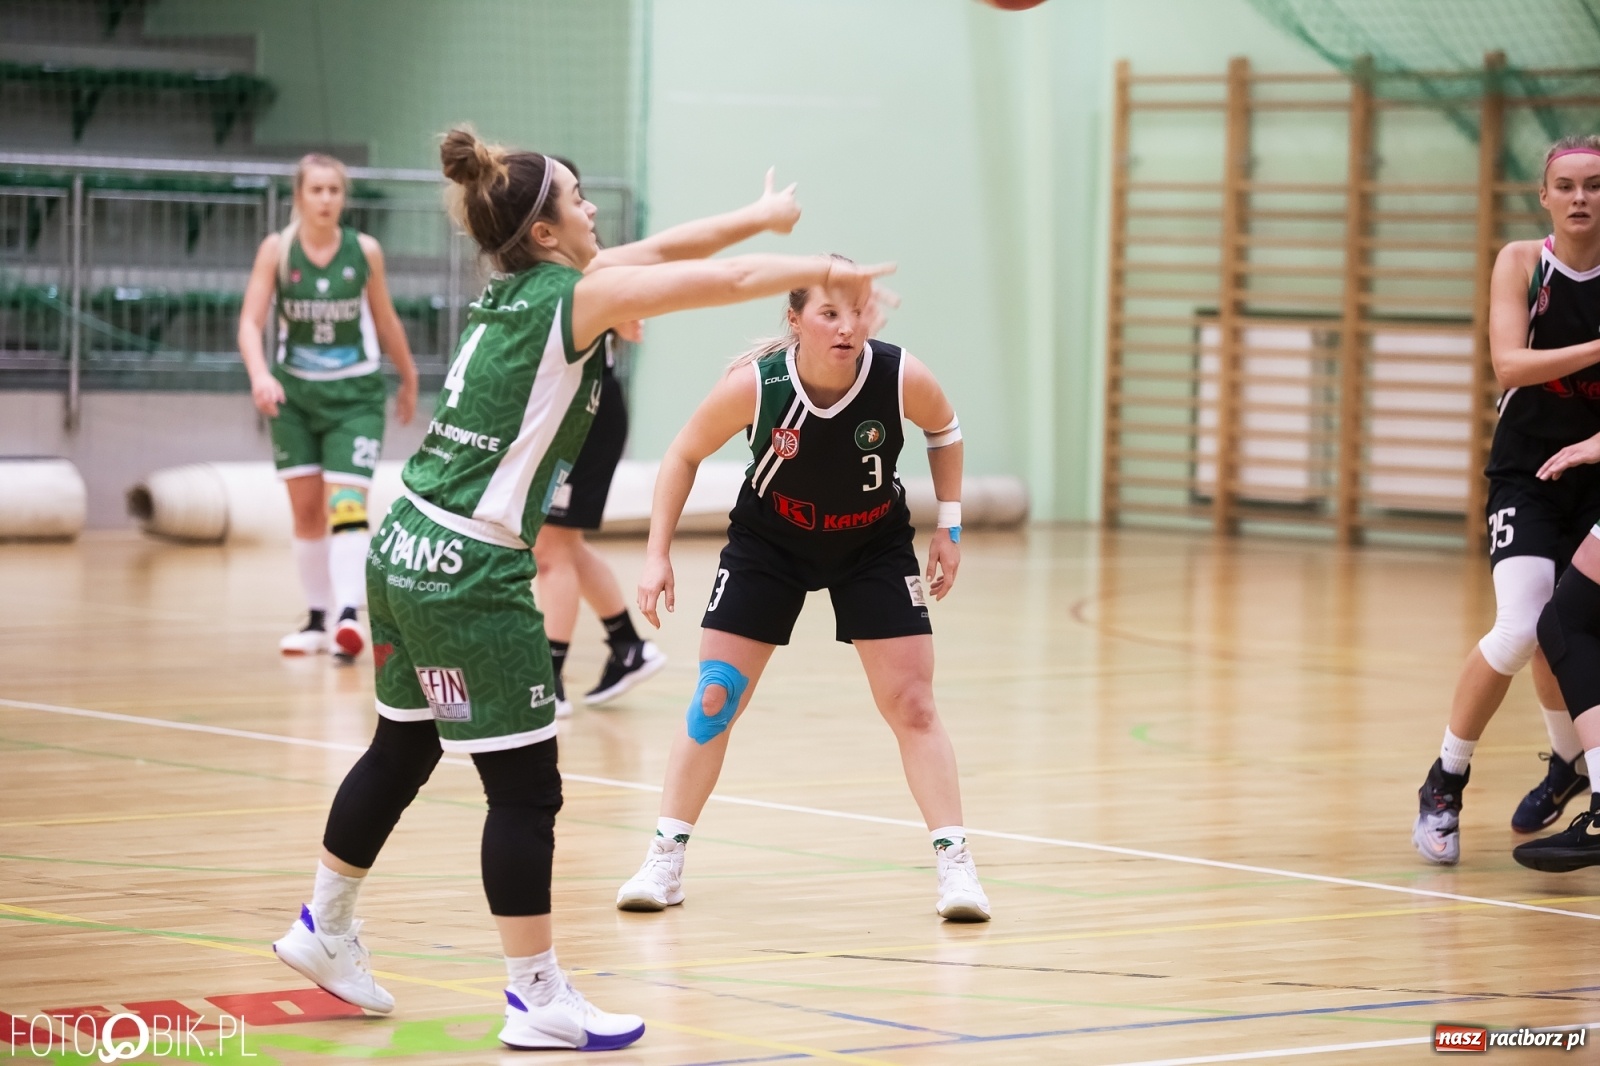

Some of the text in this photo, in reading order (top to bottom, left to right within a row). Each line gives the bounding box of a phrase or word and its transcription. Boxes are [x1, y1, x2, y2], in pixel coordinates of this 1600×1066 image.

[444, 323, 487, 408] 4
[861, 454, 883, 492] 3
[1488, 507, 1516, 555] 35
[708, 568, 730, 612] 3
